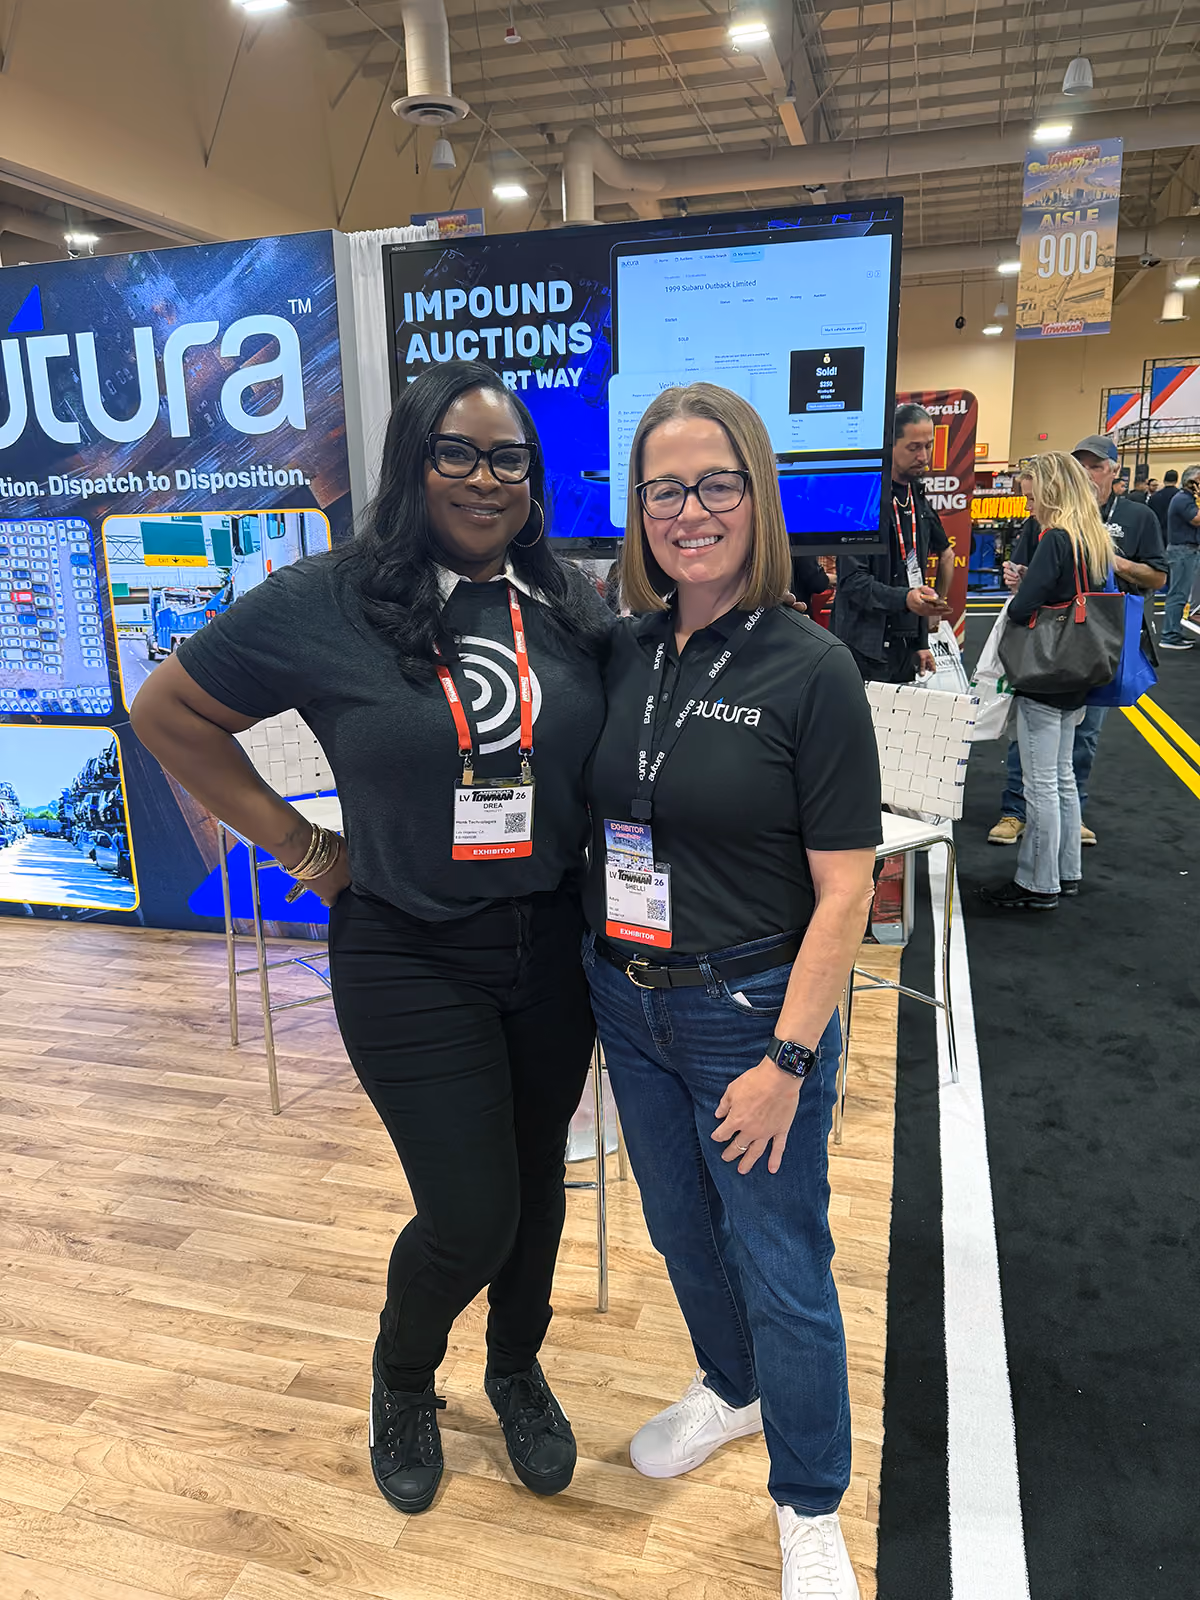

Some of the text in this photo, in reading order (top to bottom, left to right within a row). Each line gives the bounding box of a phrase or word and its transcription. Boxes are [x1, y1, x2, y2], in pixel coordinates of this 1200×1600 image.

[1040, 208, 1099, 227] AISLE
[1038, 230, 1098, 278] 900
[665, 279, 757, 294] 1999 Subaru Outback Limited
[287, 298, 312, 315] TM
[403, 280, 573, 322] IMPOUND
[405, 321, 593, 364] AUCTIONS
[536, 367, 583, 389] WAY
[815, 366, 838, 377] Sold!
[48, 471, 144, 499] Dispatch
[146, 470, 171, 491] to
[175, 465, 311, 496] Disposition.
[970, 498, 999, 519] SLOW
[653, 642, 665, 670] autura
[709, 650, 732, 679] autura
[643, 695, 654, 724] autura
[675, 699, 696, 728] autura
[638, 750, 648, 781] autura
[648, 751, 666, 782] autura
[459, 790, 526, 802] LV TOWMAN 26
[483, 802, 503, 810] DREA
[610, 822, 645, 834] EXHIBITOR
[473, 847, 516, 856] EXHIBITOR
[609, 871, 618, 879] LV
[618, 870, 652, 885] TOWMAN
[654, 878, 664, 887] 26
[625, 882, 646, 892] SHELLI
[620, 928, 655, 940] EXHIBITOR
